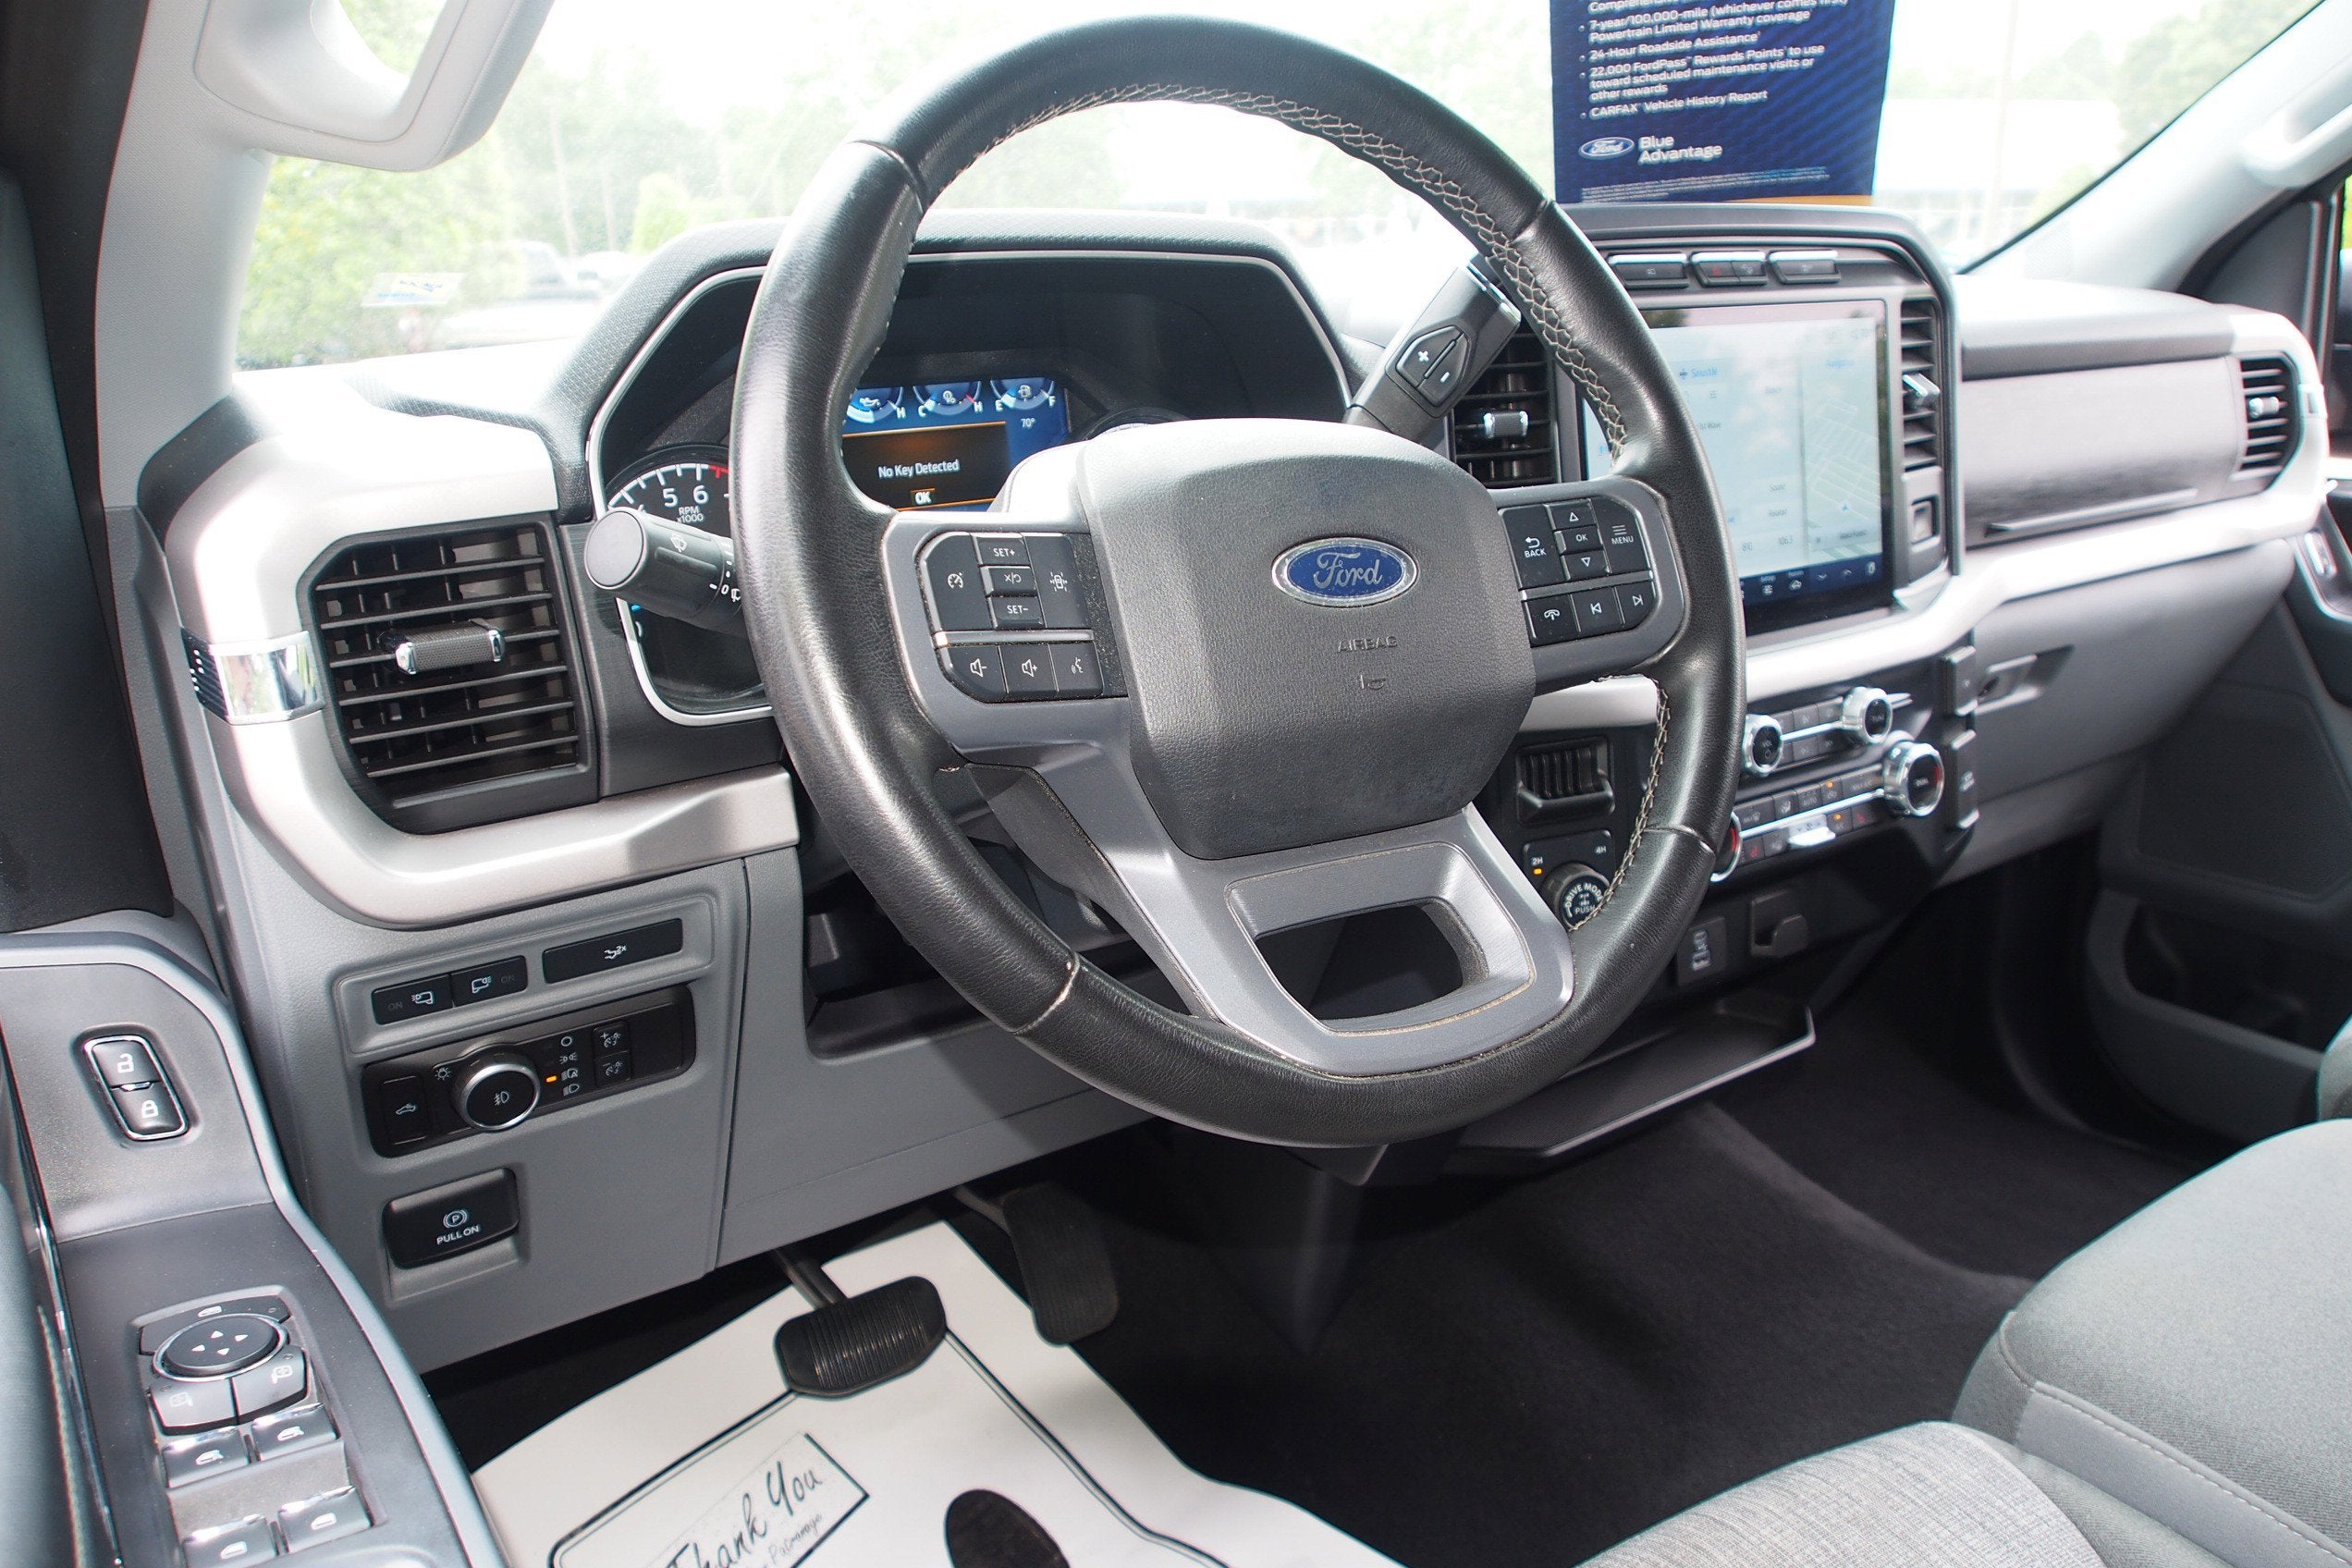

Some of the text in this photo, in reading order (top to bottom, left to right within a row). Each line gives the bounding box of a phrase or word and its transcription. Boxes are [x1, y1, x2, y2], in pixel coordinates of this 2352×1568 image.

[1710, 2, 1774, 17] (whichever
[1590, 27, 1652, 43] Powertrain
[1655, 20, 1698, 34] Limited
[1700, 16, 1754, 29] Warranty
[1590, 47, 1636, 60] 24-Hour
[1638, 40, 1693, 54] Roadside
[1590, 64, 1631, 77] 22,000
[1694, 52, 1745, 65] Rewards
[1789, 45, 1802, 55] to
[1804, 44, 1825, 55] use
[1590, 58, 1815, 89] toward scheduled maintenance visits or
[1591, 83, 1668, 101] other rewards
[1644, 98, 1684, 110] Vehicle
[1686, 95, 1727, 107] History
[1729, 91, 1768, 103] Report
[1640, 136, 1674, 149] Blue
[1640, 145, 1723, 162] Advantage
[974, 402, 983, 412] H
[996, 401, 1003, 411] E
[1048, 397, 1056, 406] F
[896, 408, 906, 418] H
[918, 407, 926, 417] C
[878, 459, 960, 478] No Key Detected
[663, 488, 678, 508] 5
[693, 485, 709, 504] 6
[915, 492, 931, 505] OK
[679, 506, 700, 515] RPM
[1575, 533, 1588, 542] OK
[1611, 535, 1634, 545] MENU
[993, 548, 1015, 557] SET+
[1525, 548, 1547, 557] BACK
[1313, 552, 1383, 589] Ford
[1007, 606, 1029, 614] SET-
[1338, 636, 1398, 653] AIRBAG
[1596, 846, 1607, 854] 4H
[1532, 857, 1543, 865] 2H
[1565, 884, 1583, 908] DRIVE
[1575, 905, 1596, 914] PUSH
[500, 974, 515, 984] ON
[387, 1001, 403, 1011] ON
[436, 1225, 480, 1245] PULL ON
[766, 1461, 823, 1515] You
[768, 1513, 823, 1563] Patronage
